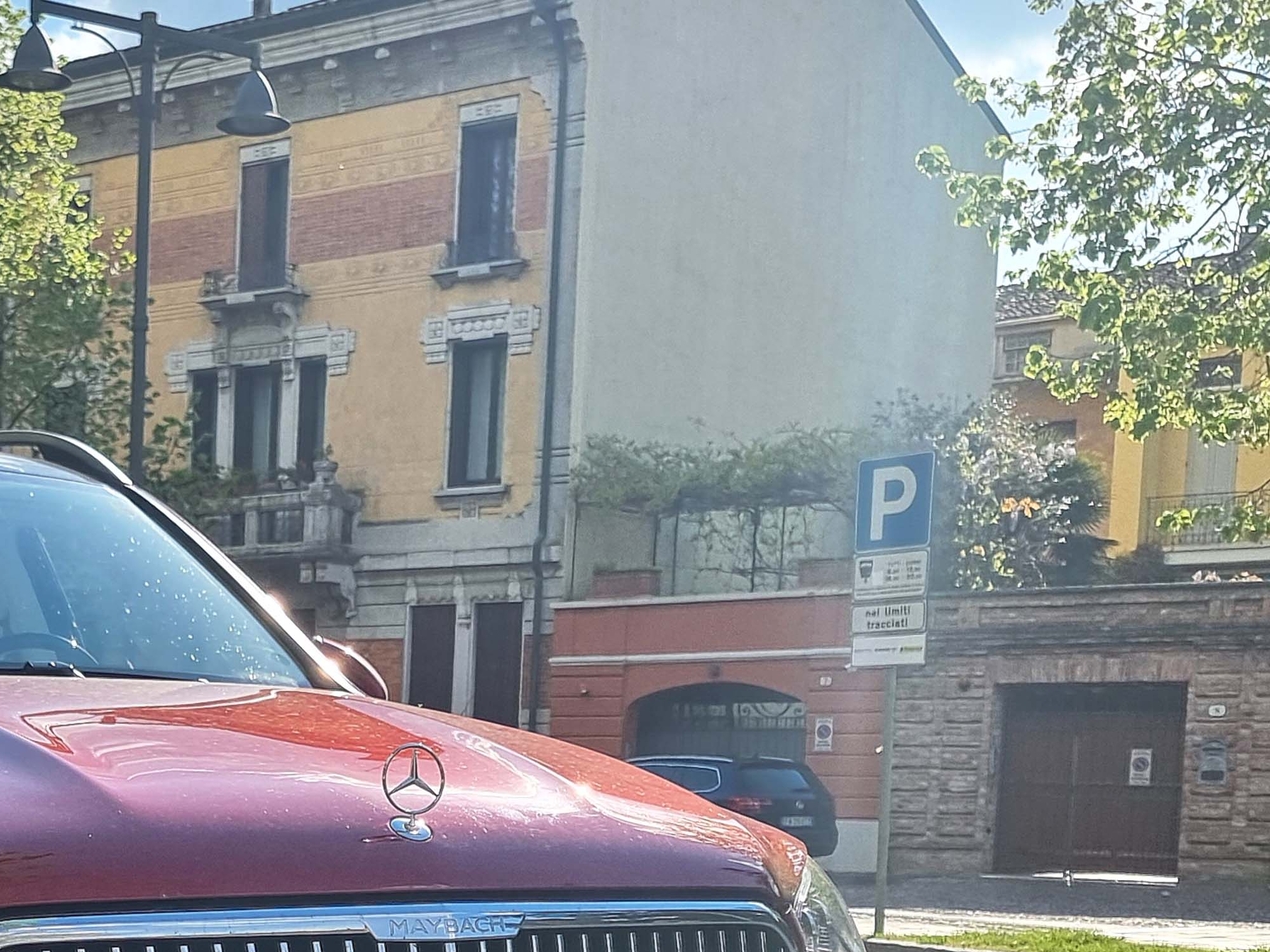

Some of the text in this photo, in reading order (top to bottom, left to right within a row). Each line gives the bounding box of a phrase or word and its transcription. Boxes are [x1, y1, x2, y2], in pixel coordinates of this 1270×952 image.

[871, 466, 917, 541] P
[885, 605, 911, 617] limiti
[867, 618, 908, 630] tracciati
[388, 916, 506, 937] MAYBACH
